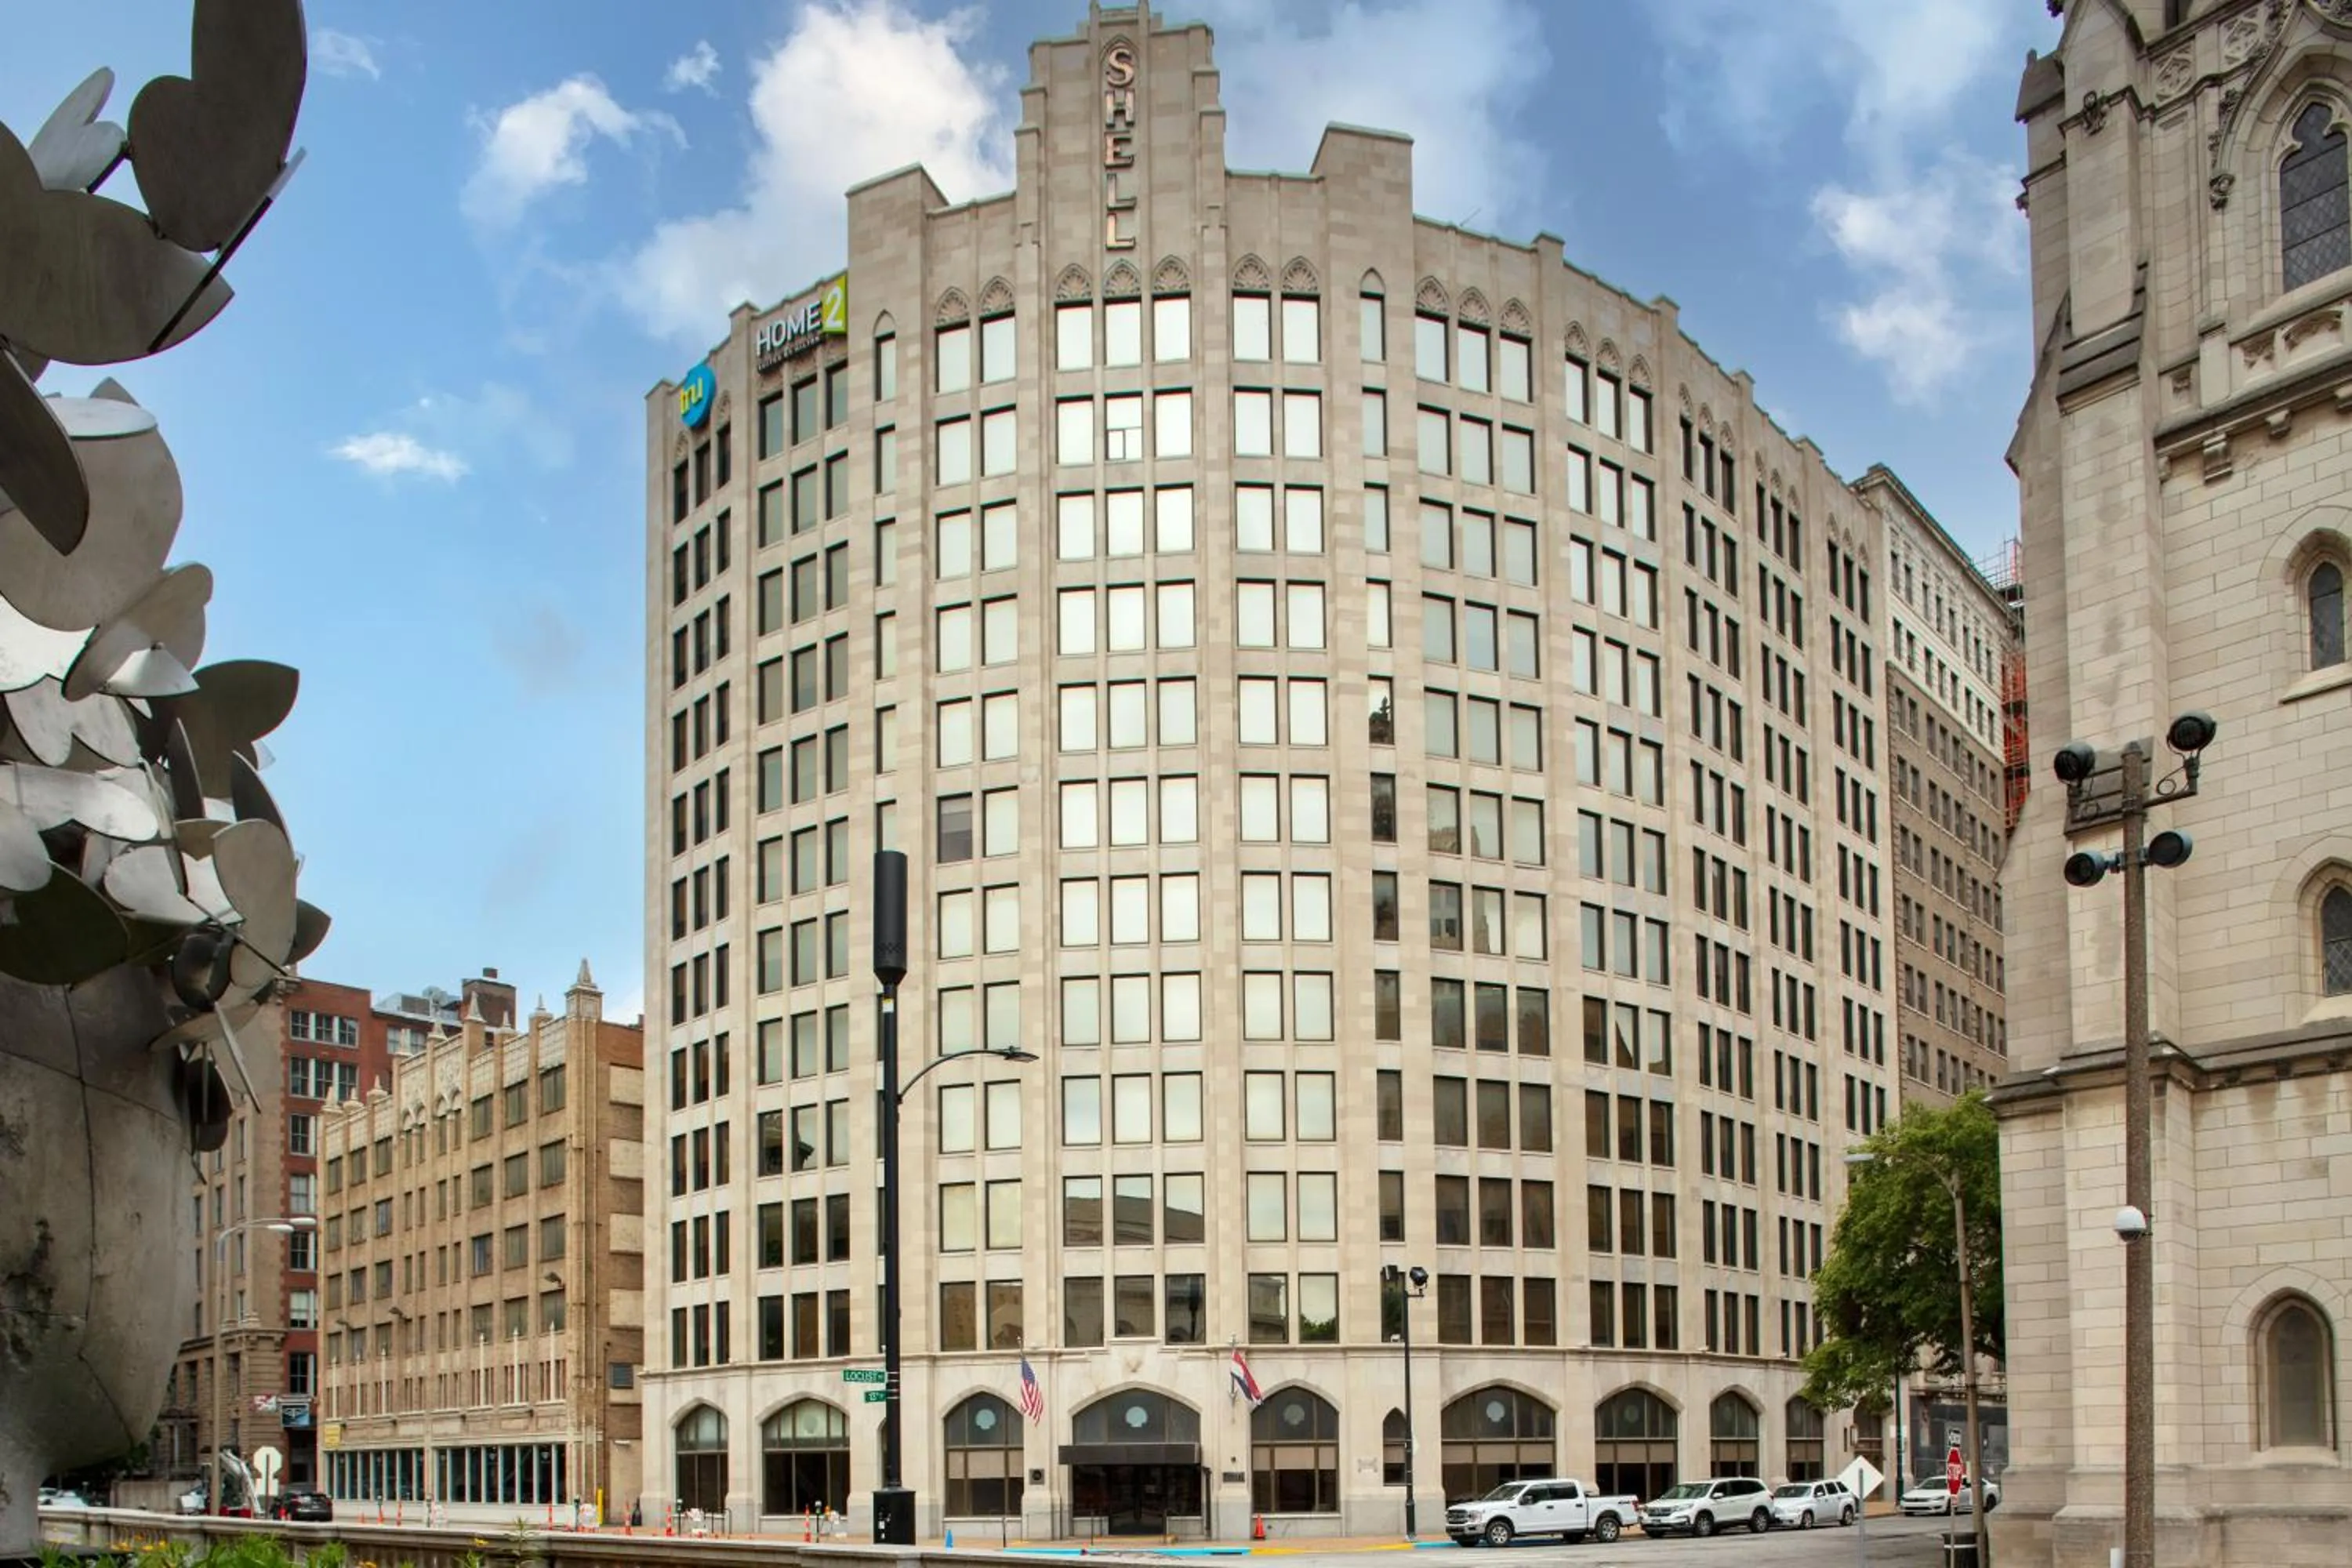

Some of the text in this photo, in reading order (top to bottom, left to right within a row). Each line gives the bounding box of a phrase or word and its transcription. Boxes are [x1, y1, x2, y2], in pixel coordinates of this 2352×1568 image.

[1105, 47, 1137, 250] SHELL
[680, 376, 703, 416] tru
[846, 1371, 877, 1381] LOCUST
